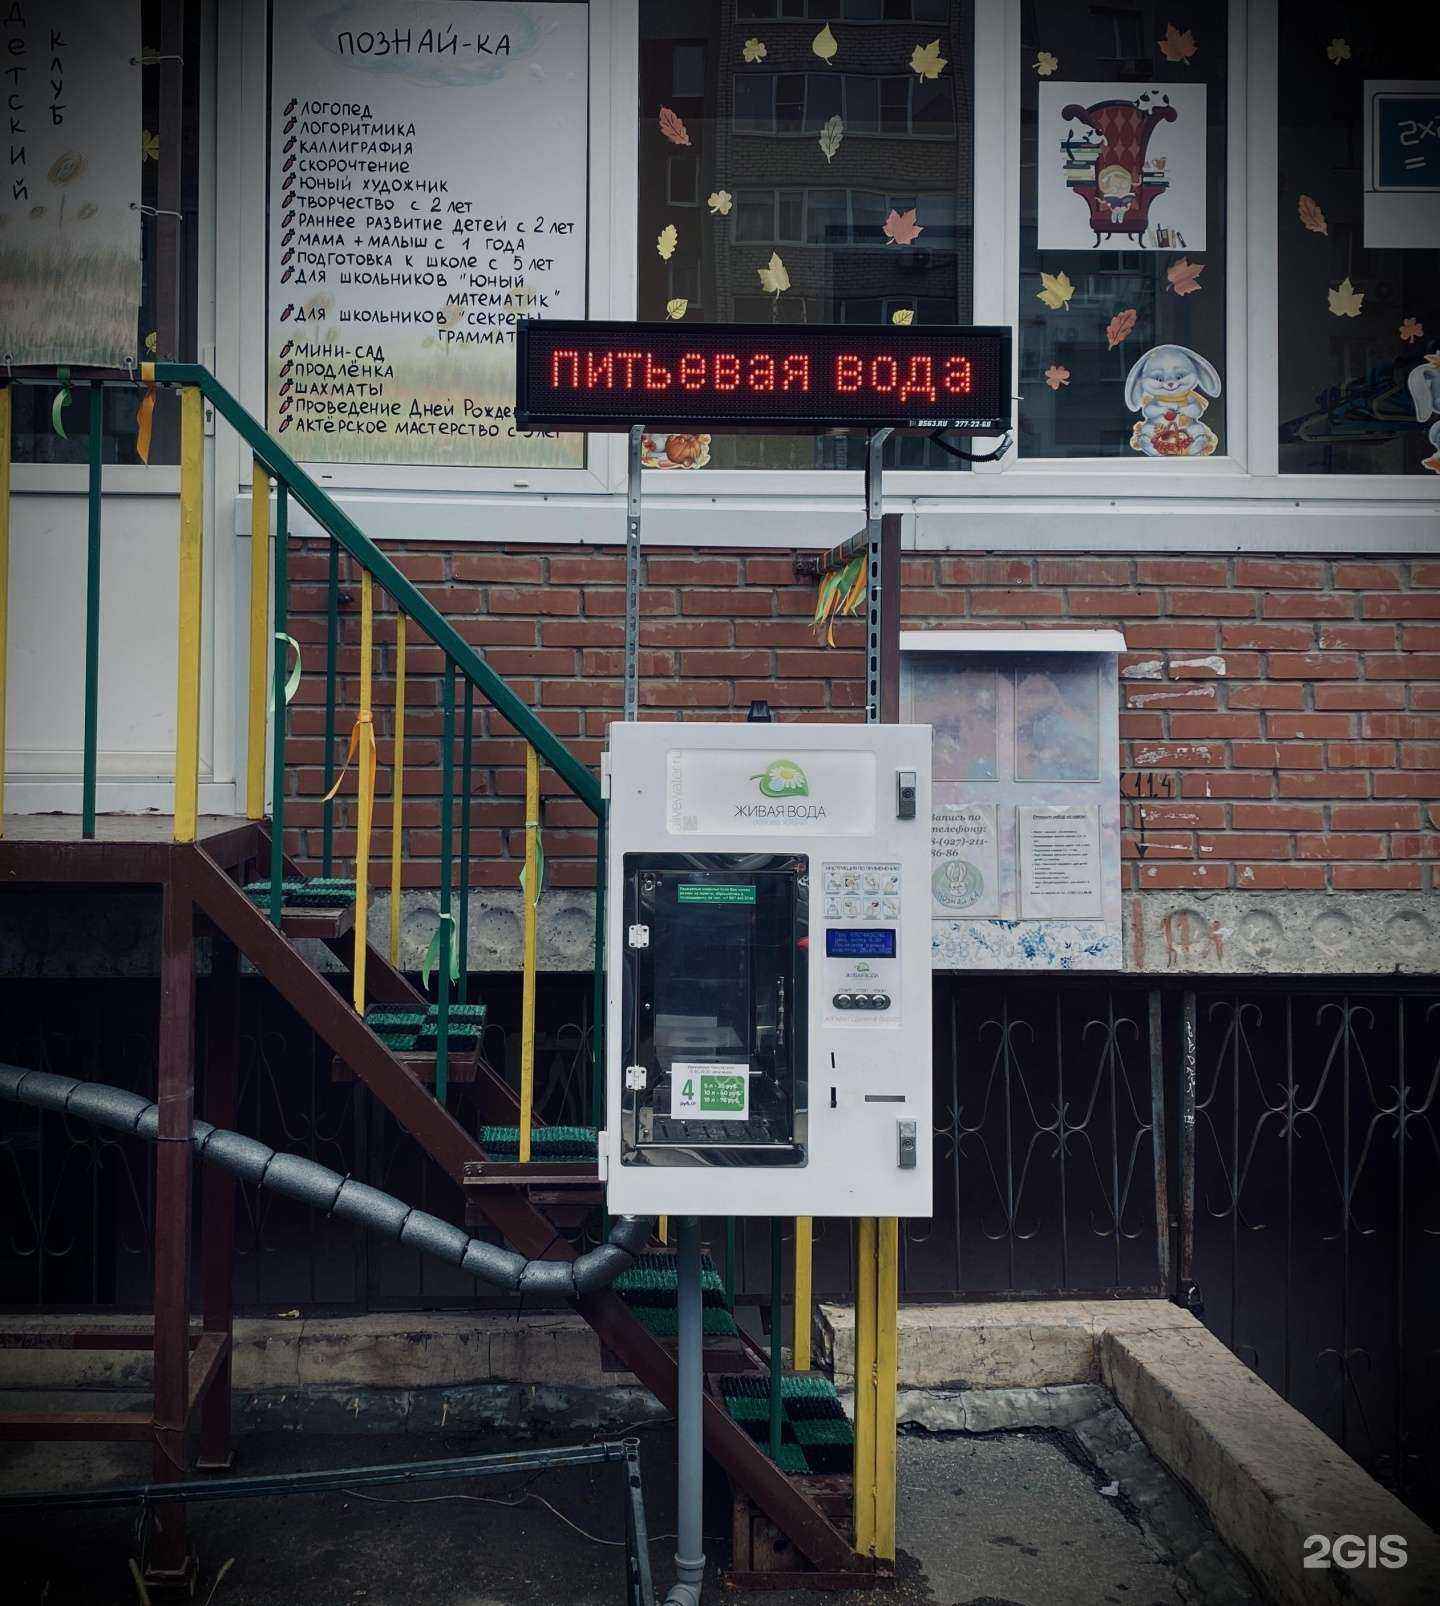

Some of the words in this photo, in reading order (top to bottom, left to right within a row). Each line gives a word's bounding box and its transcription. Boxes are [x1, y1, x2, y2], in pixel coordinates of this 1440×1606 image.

[338, 24, 511, 56] ПОЗНАЙ-КА
[300, 121, 416, 136] ЛОГОРИТМИКА
[300, 140, 413, 154] КАЛЛИГРАФИЯ
[300, 175, 351, 191] ЮНЫЙ
[362, 179, 448, 195] ХУДОЖНИК
[430, 197, 442, 213] 2
[533, 216, 545, 233] 2
[298, 233, 345, 247] МАМА
[367, 235, 428, 249] МАЛЫШ
[462, 237, 471, 251] 1
[485, 238, 526, 254] ГОДА
[297, 251, 393, 268] ПОДГОТОВКА
[513, 255, 523, 271] 5
[294, 268, 327, 285] ДЛЯ
[340, 272, 448, 287] ШКОЛЬНИКОВ
[294, 306, 326, 322] ДЛЯ
[339, 309, 447, 325] ШКОЛЬНИКОВ
[294, 342, 385, 363] МИНИ-САД
[295, 359, 394, 380] ПРОДЛЁНКА
[294, 381, 384, 398] ШАХМАТЫ
[463, 398, 517, 420] Рожде
[735, 806, 785, 818] ЖИВАЯ
[787, 805, 827, 820] ВОДА
[681, 1078, 695, 1101] 4
